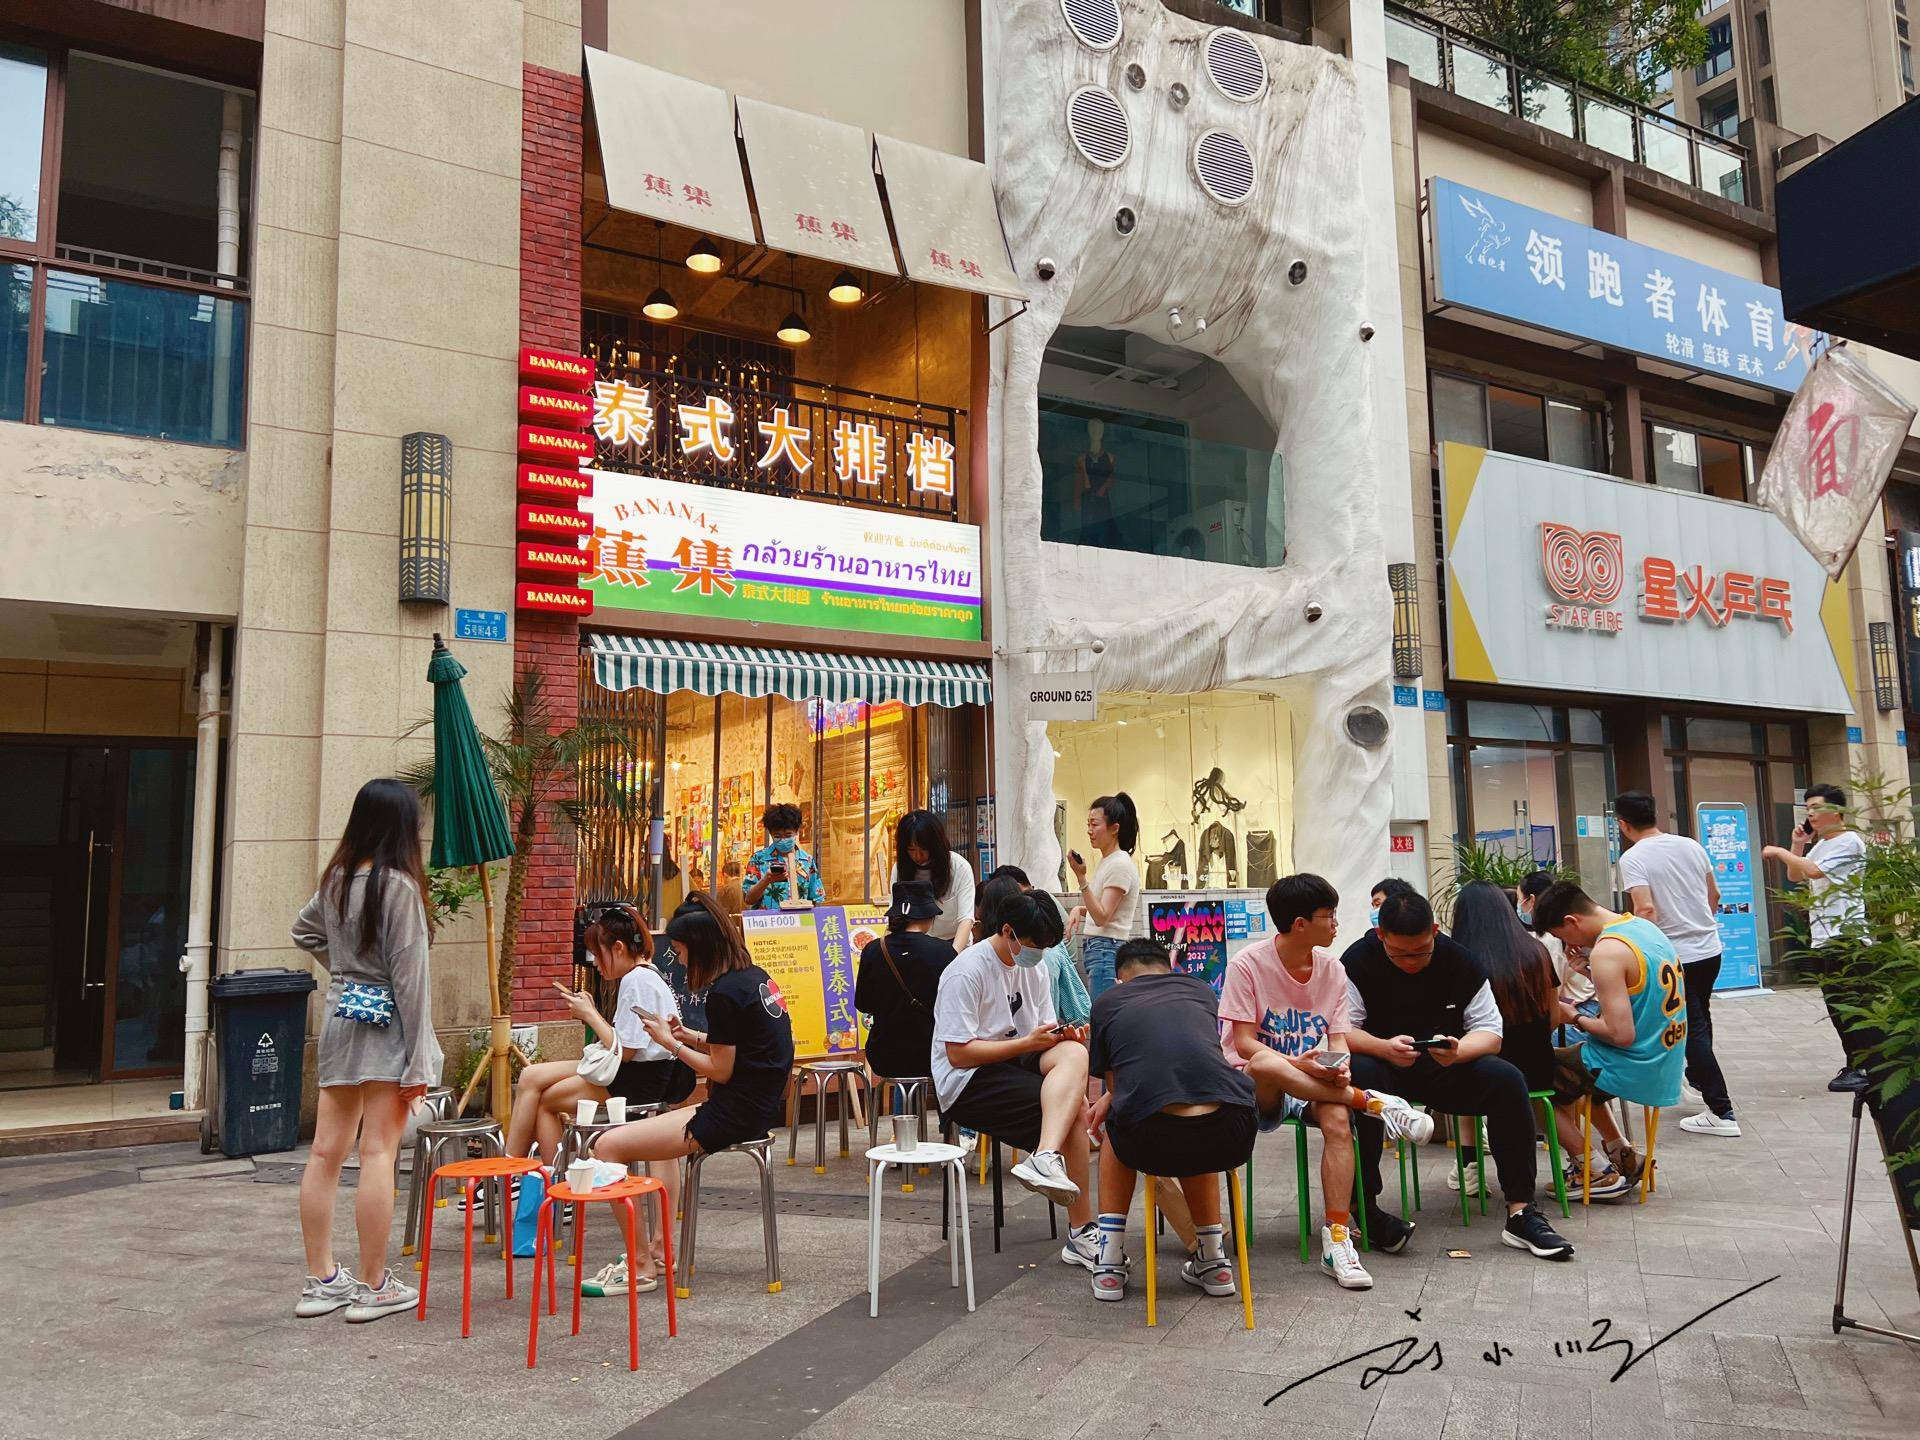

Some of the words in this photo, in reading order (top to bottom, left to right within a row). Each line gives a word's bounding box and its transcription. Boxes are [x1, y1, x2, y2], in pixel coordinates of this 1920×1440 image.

[1524, 228, 1775, 351] 领跑者体育
[1665, 331, 1695, 359] 轮滑
[1702, 342, 1730, 368] 篮球
[1737, 353, 1764, 377] 武术
[529, 355, 588, 375] BANANA+
[529, 394, 588, 413] BANANA+
[528, 433, 588, 451] BANANA+
[592, 379, 955, 496] 泰式大排档
[528, 472, 587, 491] BANANA+
[528, 512, 587, 529] BANANA+
[527, 551, 587, 567] BANANA+
[583, 526, 737, 598] 蕉集
[742, 538, 971, 588] กล้วยร้านอาหารไทย
[526, 591, 587, 607] BANANA+
[1643, 556, 1794, 634] 星火乒乓
[1549, 604, 1590, 626] STAR
[1593, 608, 1624, 632] FIRE
[1030, 691, 1072, 702] GROUND
[1074, 691, 1092, 702] 625
[747, 918, 768, 929] Thai
[771, 916, 795, 927] FOOD
[1187, 925, 1224, 944] RAY
[663, 946, 677, 966] 今
[1186, 952, 1207, 960] 2022
[821, 914, 853, 1023] 蕉集泰式
